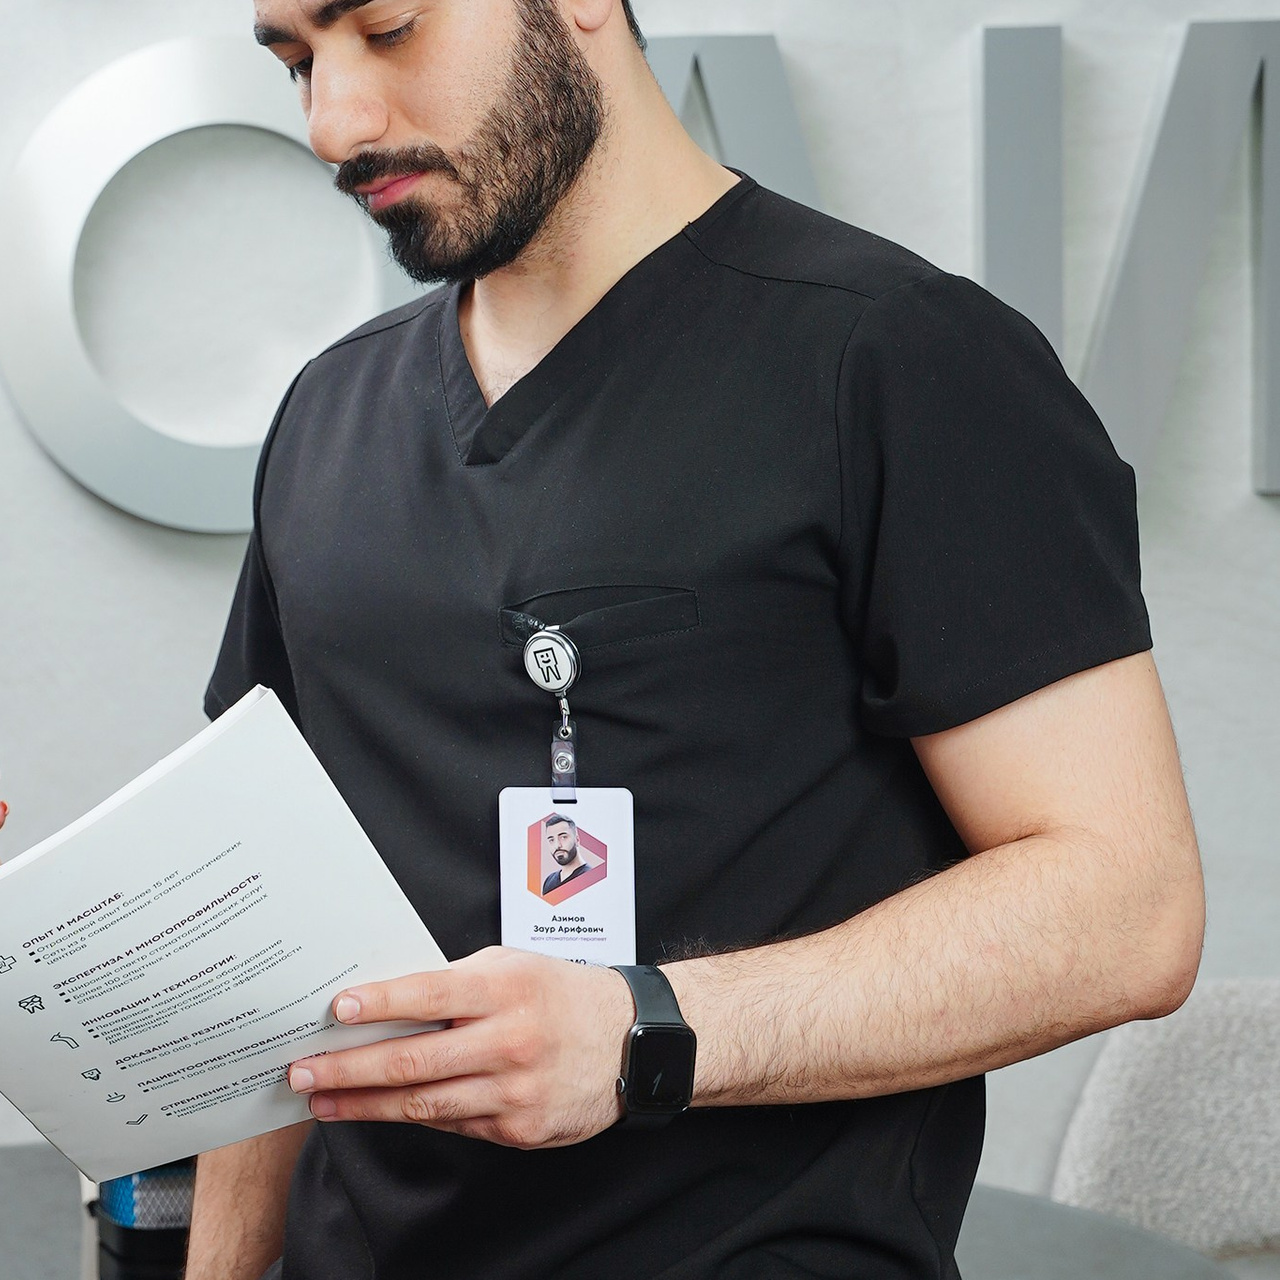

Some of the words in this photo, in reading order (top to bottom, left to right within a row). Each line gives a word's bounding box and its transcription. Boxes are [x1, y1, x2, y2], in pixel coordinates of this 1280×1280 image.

[22, 929, 54, 949] ОПЫТ
[66, 890, 124, 926] МАСШТАБ:
[36, 921, 92, 953] Отраслевой
[94, 906, 120, 922] опыт
[122, 887, 152, 907] более
[162, 870, 180, 882] лет
[42, 946, 66, 960] Сеть
[88, 898, 152, 937] современных
[152, 840, 242, 900] стоматологических
[52, 952, 124, 991] ЭКСПЕРТИЗА
[134, 871, 262, 951] МНОГОПРОФИЛЬНОСТЬ:
[533, 924, 556, 933] Заур
[558, 924, 604, 934] Арифович
[551, 915, 586, 923] Азимов
[46, 943, 88, 965] центров
[66, 971, 111, 994] Широкий
[114, 953, 148, 973] спектр
[148, 901, 238, 955] стоматологических
[238, 884, 263, 902] услуг
[72, 985, 100, 1000] Более
[104, 976, 120, 987] 100
[122, 955, 164, 978] опытных
[172, 892, 268, 953] сертифицированных
[76, 971, 145, 1005] специалистов
[80, 995, 150, 1027] ИННОВАЦИИ
[162, 952, 238, 995] ТЕХНОЛОГИИ:
[94, 1006, 149, 1031] Передовое
[150, 977, 214, 1009] медицинское
[214, 938, 282, 979] оборудование
[100, 1013, 153, 1037] Внедрение
[154, 978, 230, 1016] искусственного
[232, 949, 284, 980] интеллекта
[180, 988, 224, 1011] точности
[232, 945, 302, 987] эффективности
[114, 1034, 190, 1065] ДОКАЗАННЫЕ
[191, 1006, 260, 1038] РЕЗУЛЬТАТЫ:
[128, 1054, 157, 1068] Более
[172, 1043, 192, 1053] 000
[192, 1026, 236, 1046] успешно
[236, 993, 310, 1029] установленных
[310, 963, 358, 995] имплантов
[136, 1018, 320, 1088] ПАЦИЕНТООРИЕНТИРОВАННОСТЬ:
[150, 1077, 180, 1090] Более
[186, 1068, 206, 1079] 000
[206, 1062, 226, 1072] 000
[228, 1039, 292, 1065] проведенных
[294, 1022, 335, 1042] приемов
[160, 1083, 230, 1112] СТРЕМЛЕНИЕ
